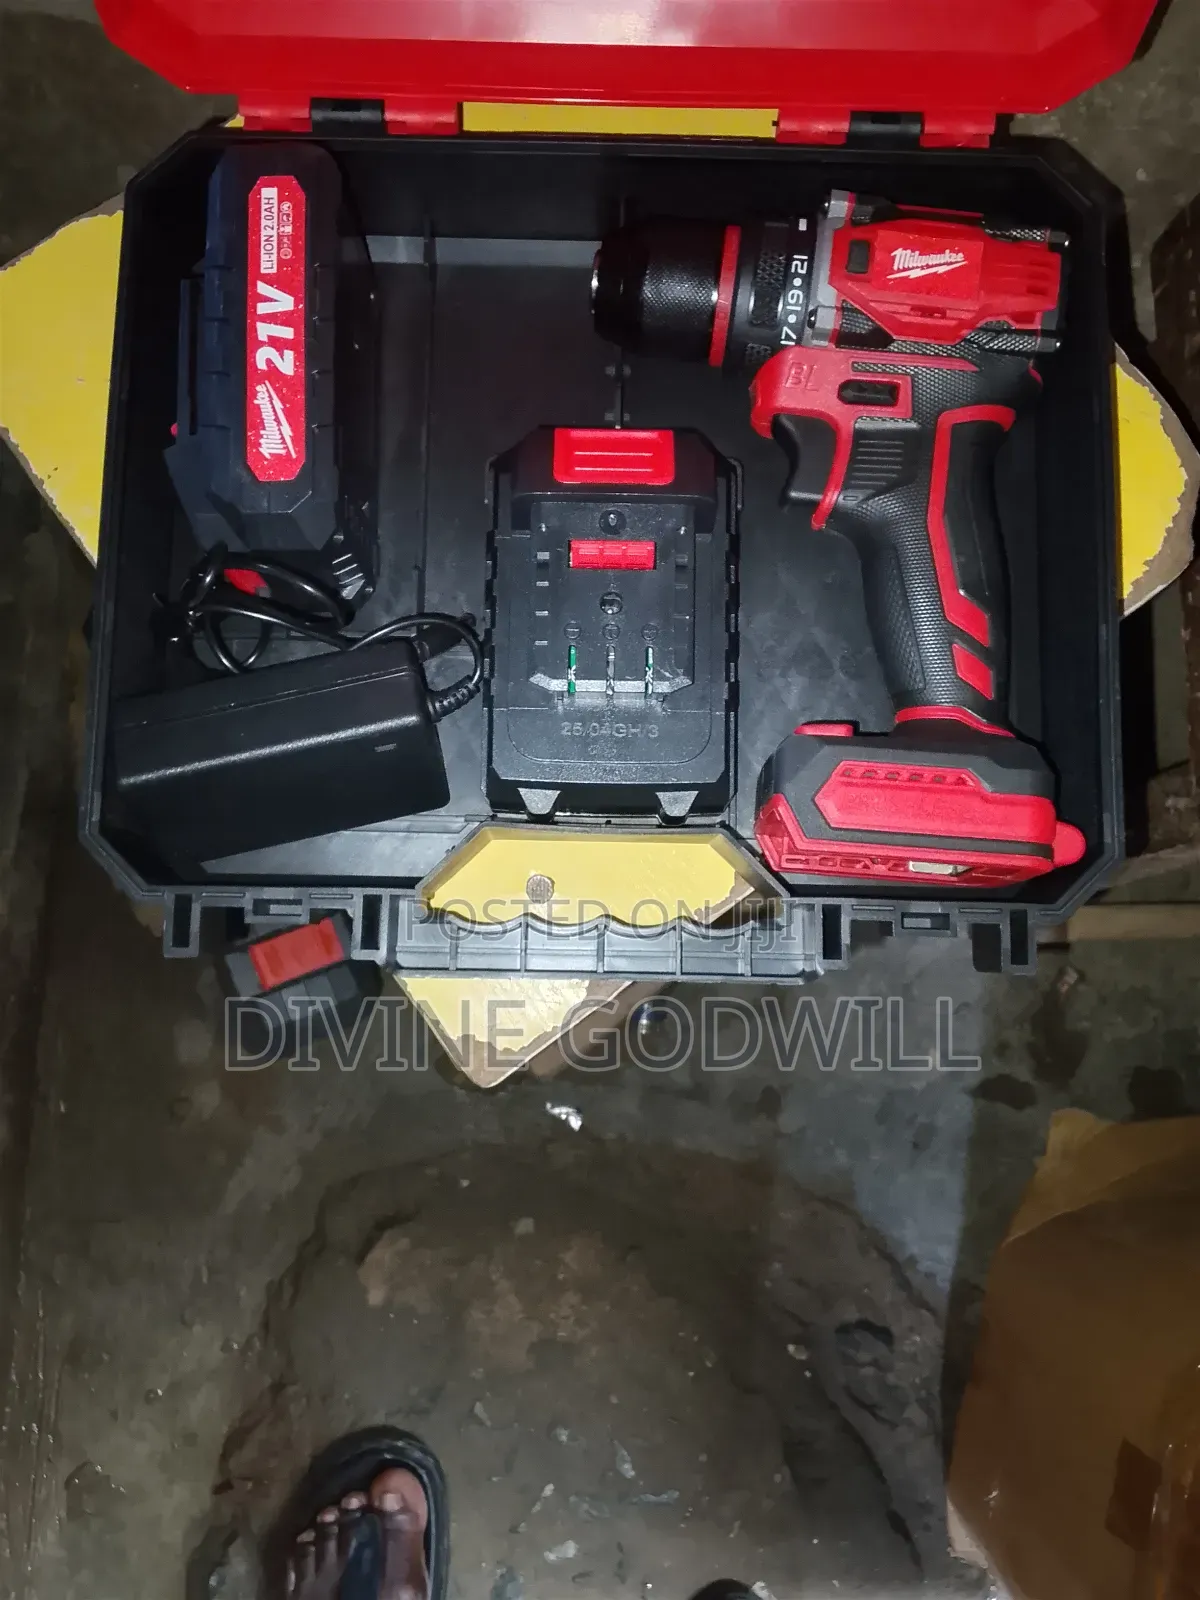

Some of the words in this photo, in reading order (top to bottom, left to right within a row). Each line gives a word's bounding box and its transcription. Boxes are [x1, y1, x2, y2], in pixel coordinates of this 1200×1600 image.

[263, 197, 275, 231] 2.0AH
[791, 254, 808, 274] 21
[891, 247, 965, 272] Milwaukee
[786, 289, 804, 311] 19
[256, 280, 295, 376] 21V
[780, 325, 797, 346] 17
[253, 382, 288, 459] Milwaukee
